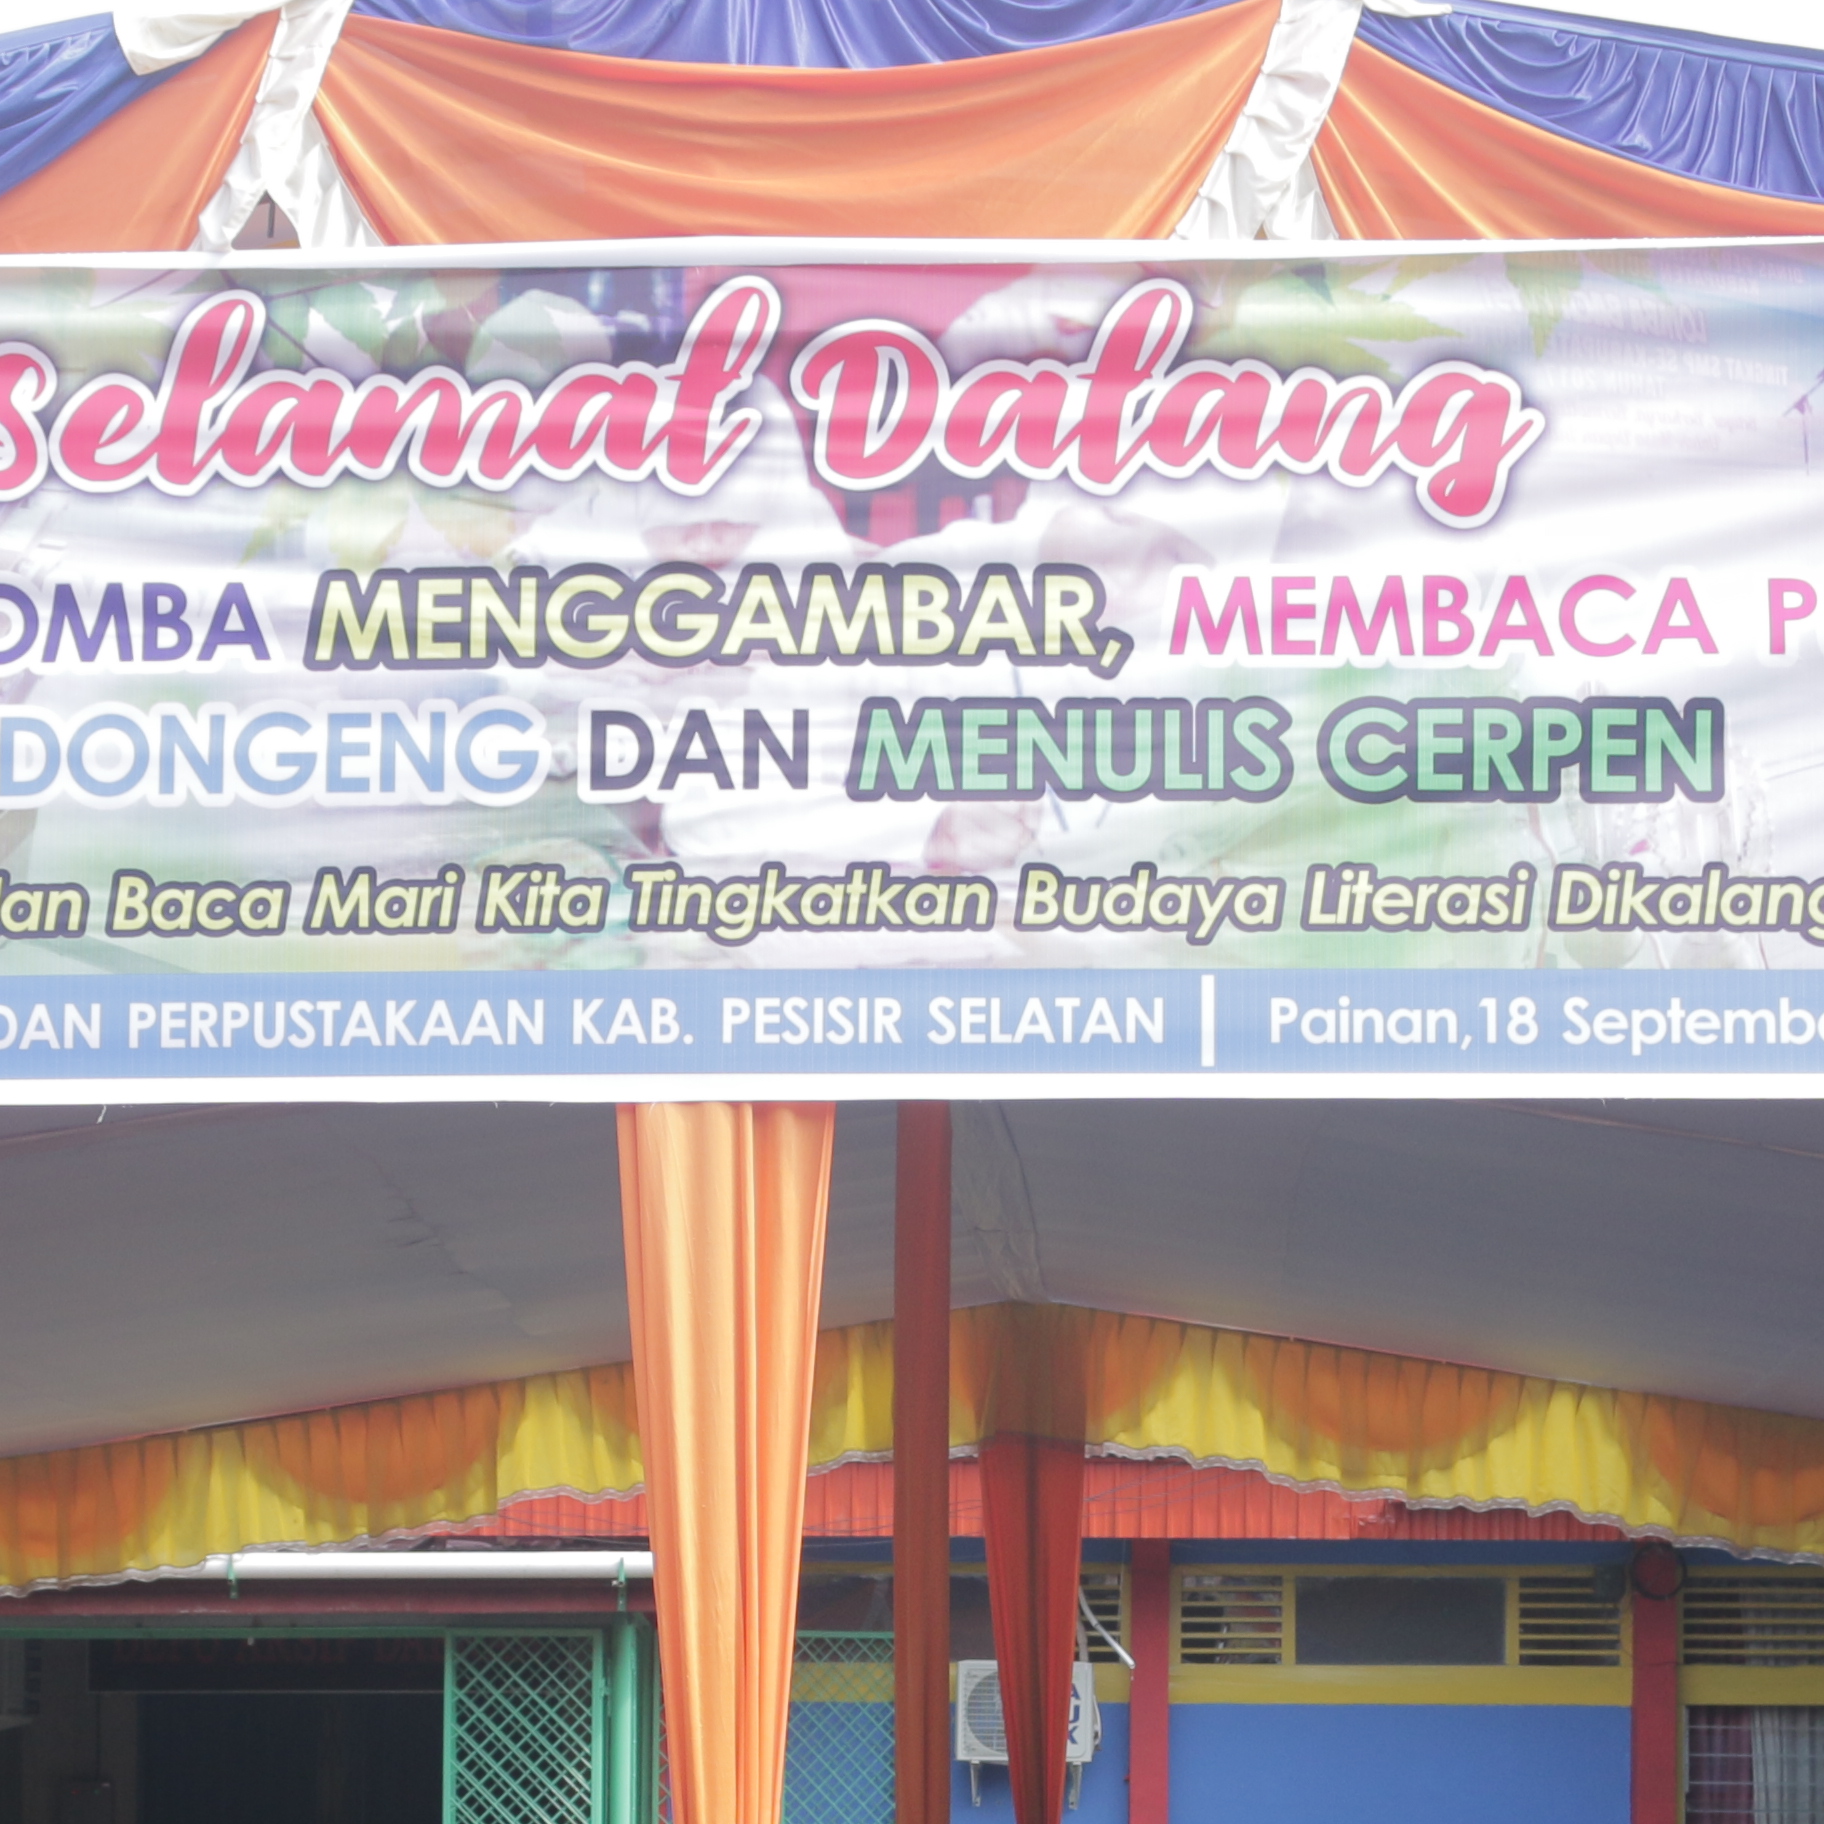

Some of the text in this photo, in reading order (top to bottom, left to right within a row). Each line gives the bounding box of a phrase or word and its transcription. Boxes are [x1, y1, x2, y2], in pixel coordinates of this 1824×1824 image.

[798, 288, 1535, 517] Datang
[314, 572, 1127, 670] MENGGAMBAR,
[1169, 574, 1718, 657] MEMBACA
[590, 708, 811, 791] DAN
[859, 707, 1285, 792] MENULIS
[1328, 708, 1713, 794] CERPEN
[112, 873, 285, 928] Baca
[312, 872, 457, 930] Mari
[484, 871, 602, 928] Kita
[631, 870, 990, 942] Tingkatkan
[1021, 870, 1279, 942] Budaya
[1309, 869, 1528, 928] Literasi
[128, 1002, 545, 1051] PERPUSTAKAAN
[572, 1000, 695, 1047] KAB.
[720, 999, 901, 1047] PESISIR
[926, 998, 1165, 1047] SELATAN
[1270, 998, 1539, 1052] Painan,18
